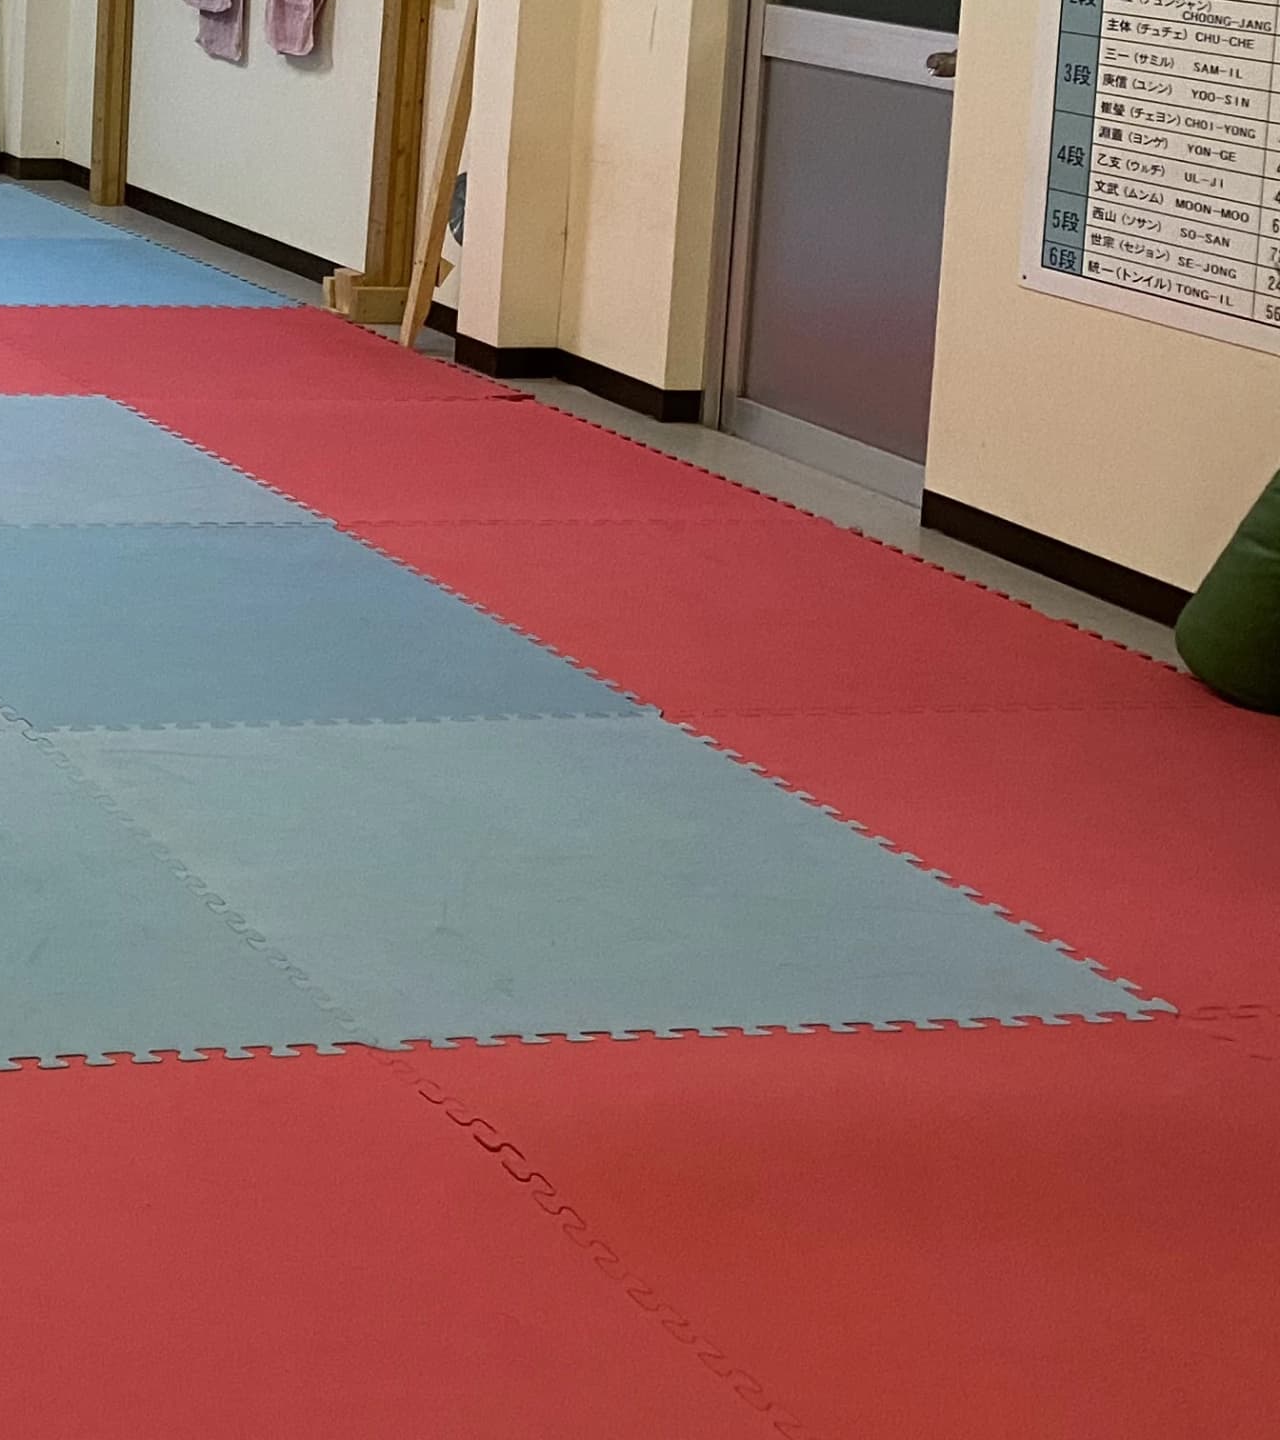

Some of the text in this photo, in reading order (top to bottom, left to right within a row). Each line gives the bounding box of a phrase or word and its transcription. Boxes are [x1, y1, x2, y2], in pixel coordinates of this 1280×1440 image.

[1182, 11, 1273, 32] CHOONG-JANG
[1195, 32, 1255, 49] CHU-CHE
[1064, 63, 1091, 86] 3段
[1193, 63, 1243, 79] SAM-IL
[1192, 89, 1250, 108] YOO-SIN
[1185, 117, 1256, 139] CHOI-YONG
[1057, 145, 1085, 168] 4段
[1187, 144, 1238, 162] YON-GE
[1184, 172, 1224, 188] UL-JI
[1052, 209, 1079, 233] 5段
[1176, 198, 1250, 223] MOON-MOO
[1180, 228, 1231, 248] SO-SAN
[1049, 247, 1076, 271] 6段
[1178, 257, 1237, 279] SE-JONG
[1177, 284, 1235, 306] TONG-IL
